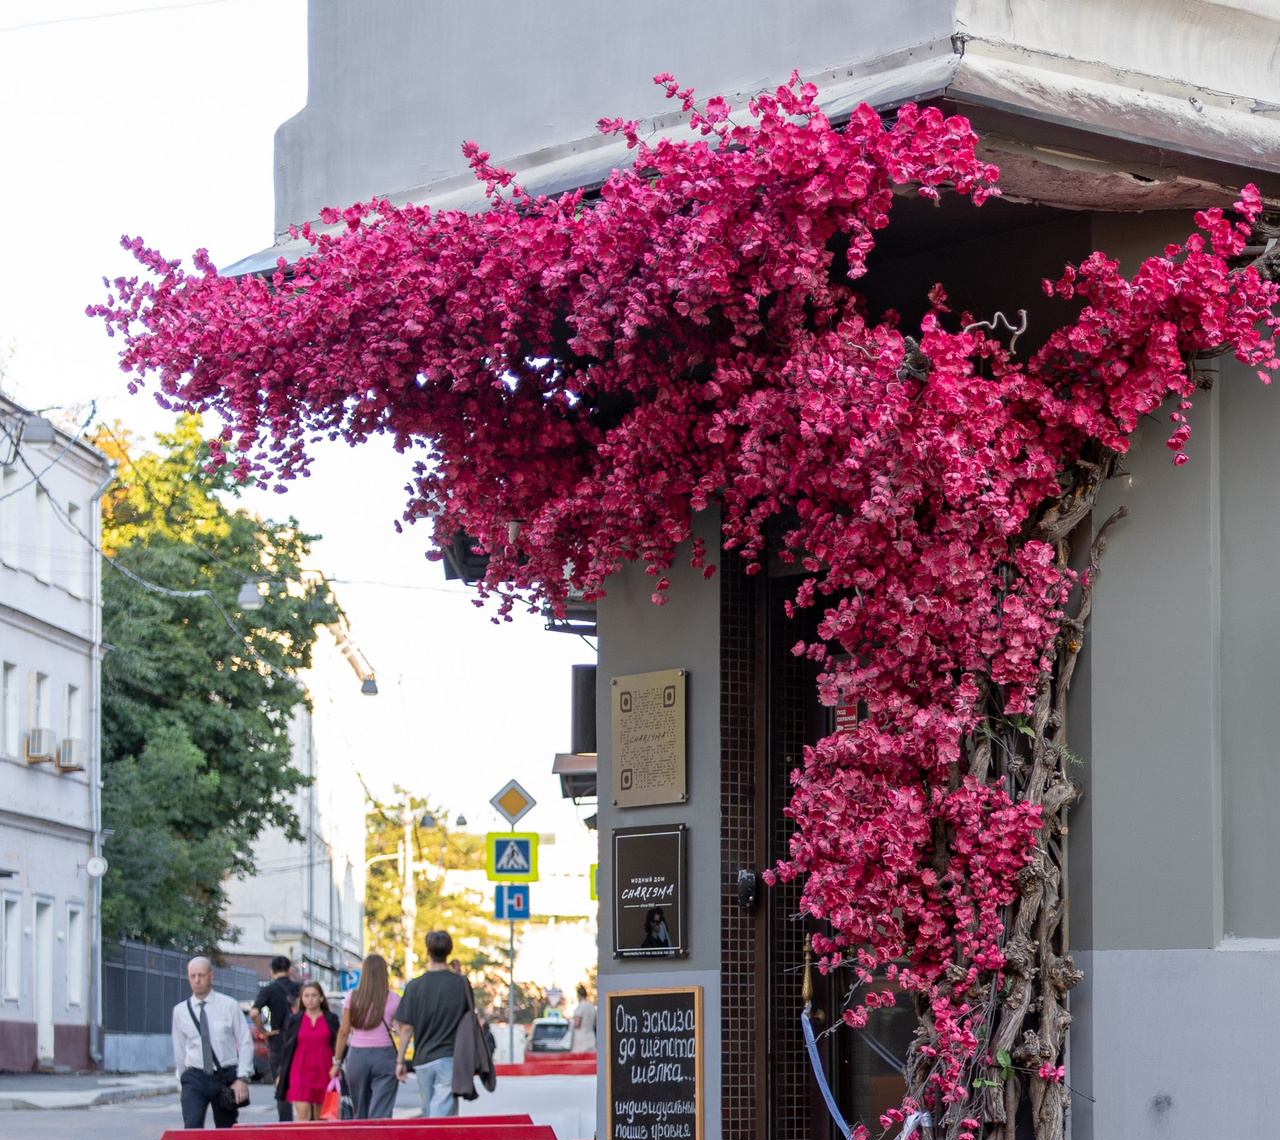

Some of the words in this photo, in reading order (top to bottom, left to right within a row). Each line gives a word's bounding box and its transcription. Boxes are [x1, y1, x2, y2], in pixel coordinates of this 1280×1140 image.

[629, 731, 666, 744] CHARISMA
[630, 876, 653, 884] МОДНЫЙ
[621, 884, 675, 901] CHARISMA
[615, 1004, 638, 1034] От
[642, 1007, 695, 1034] эскиза
[618, 1038, 636, 1065] до
[640, 1036, 696, 1058] шёпота
[615, 1123, 648, 1139] пошив
